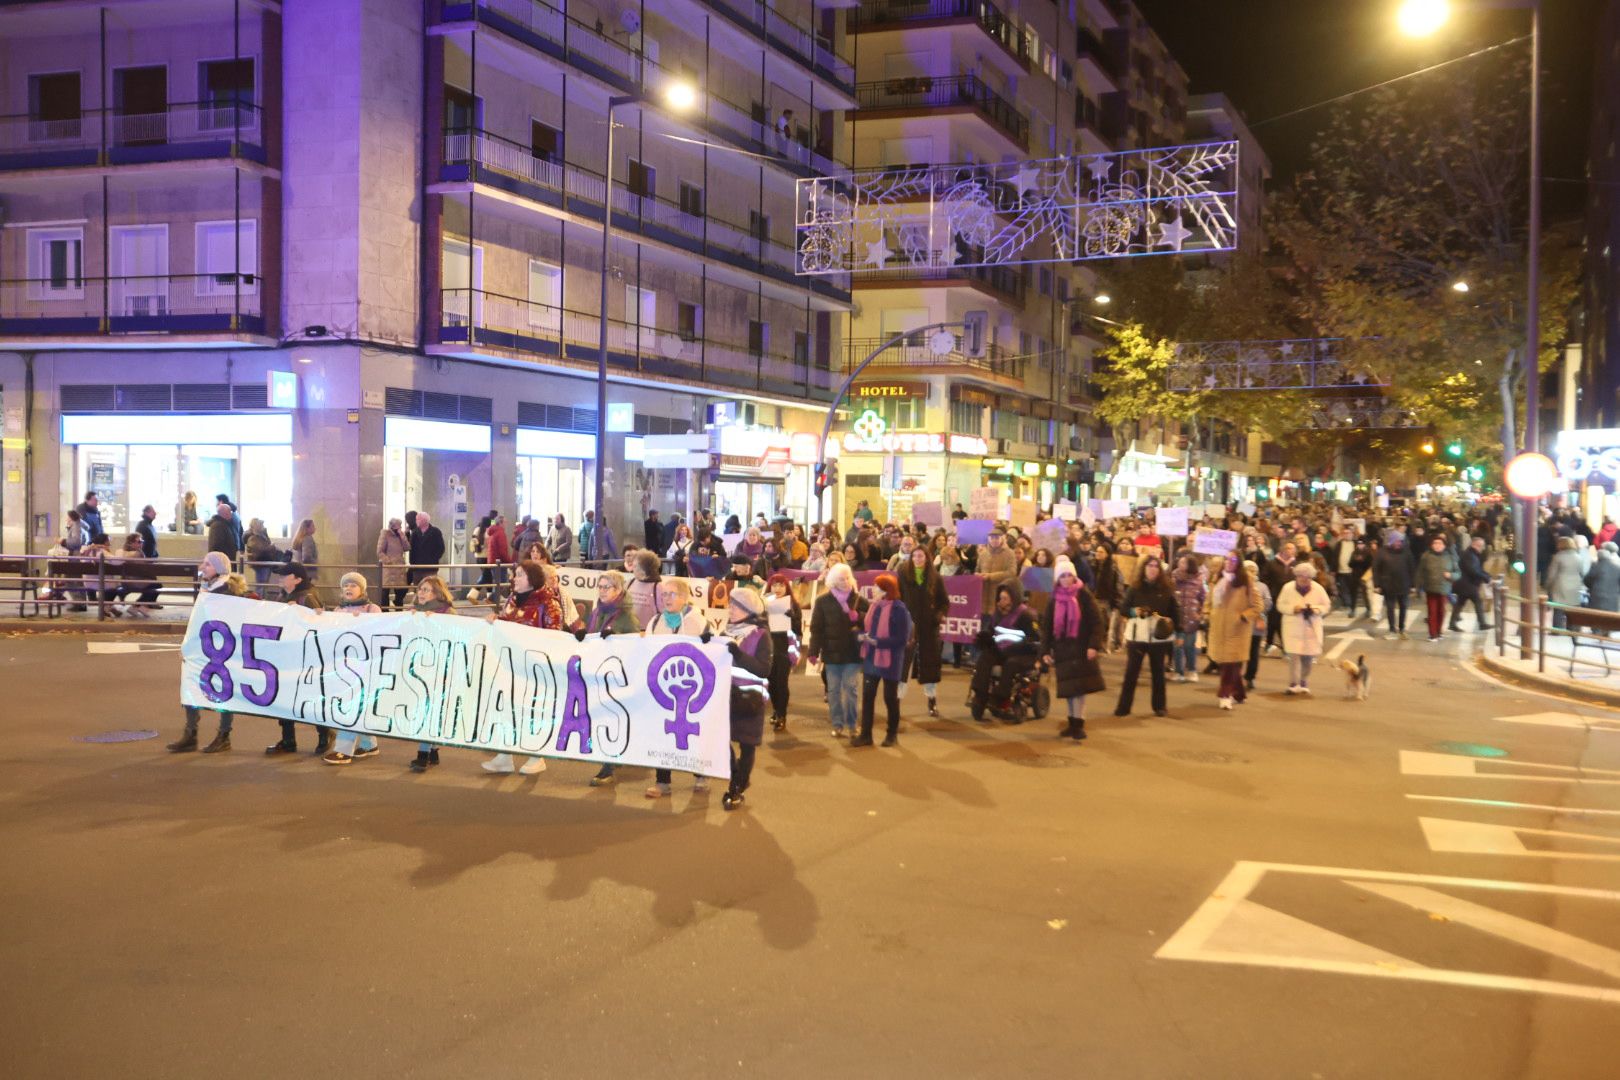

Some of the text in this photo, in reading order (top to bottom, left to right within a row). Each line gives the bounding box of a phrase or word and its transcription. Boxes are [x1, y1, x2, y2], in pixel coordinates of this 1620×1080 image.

[860, 386, 908, 396] HOTEL
[199, 619, 631, 758] 85 ASESINADAS
